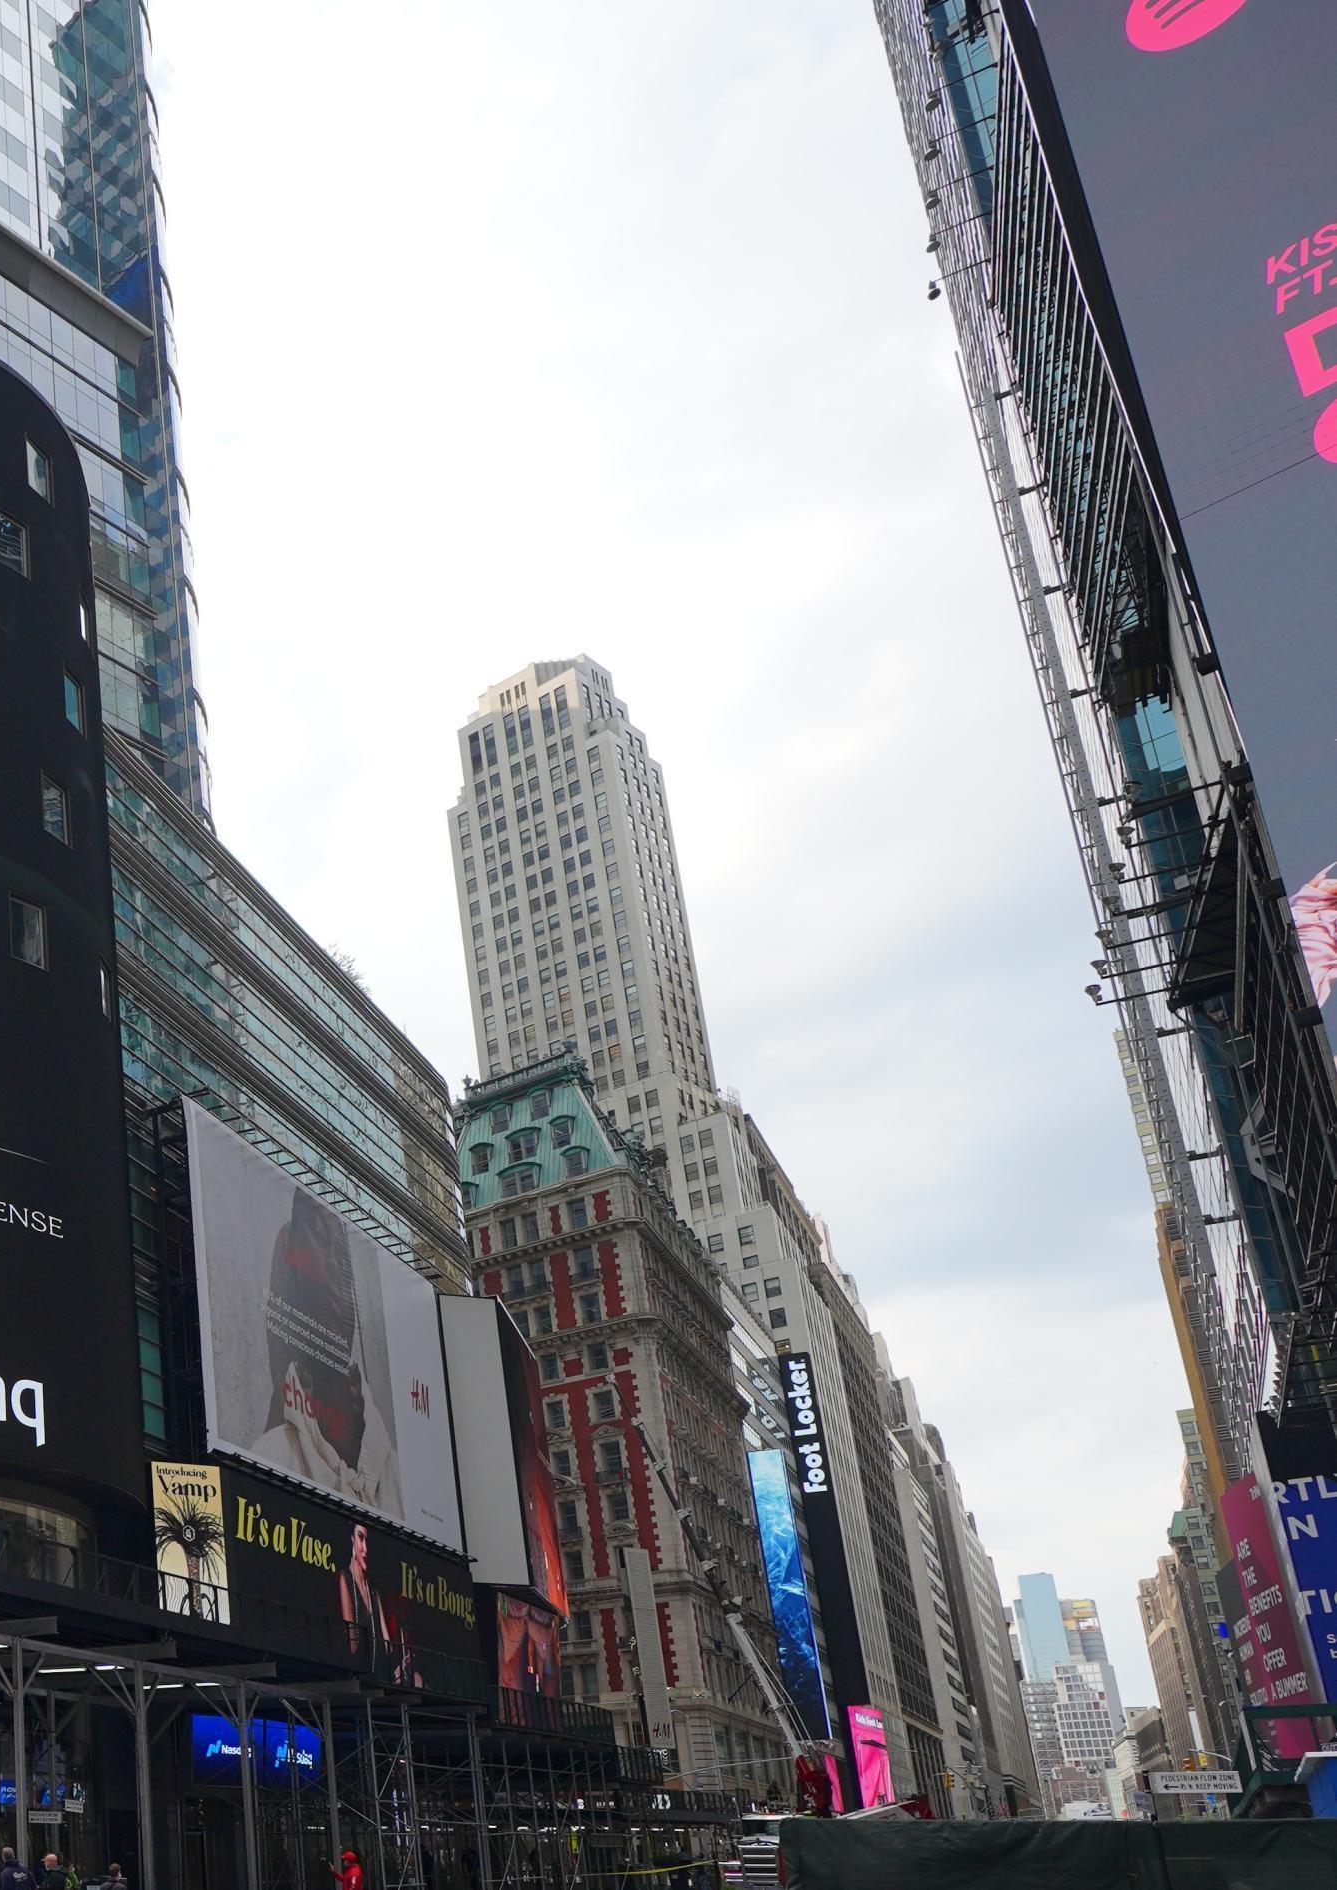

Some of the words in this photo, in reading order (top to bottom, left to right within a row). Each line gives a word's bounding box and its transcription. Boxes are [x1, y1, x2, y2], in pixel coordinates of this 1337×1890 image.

[156, 1465, 208, 1479] Introducing
[798, 1442, 828, 1493] Foot
[158, 1475, 217, 1502] Vamp
[235, 1496, 268, 1548] It's
[272, 1526, 287, 1552] a
[289, 1516, 336, 1573] Vase.
[1236, 1538, 1251, 1562] ARE
[1242, 1566, 1257, 1588] THE
[400, 1560, 424, 1604] It's
[425, 1581, 435, 1606] a
[436, 1574, 478, 1631] Bong.
[1248, 1584, 1283, 1617] BENEFITS
[1255, 1622, 1271, 1643] YOU
[1263, 1648, 1287, 1673] OFFER
[1270, 1683, 1278, 1701] A
[1161, 1774, 1198, 1782] PEDESTRIAN
